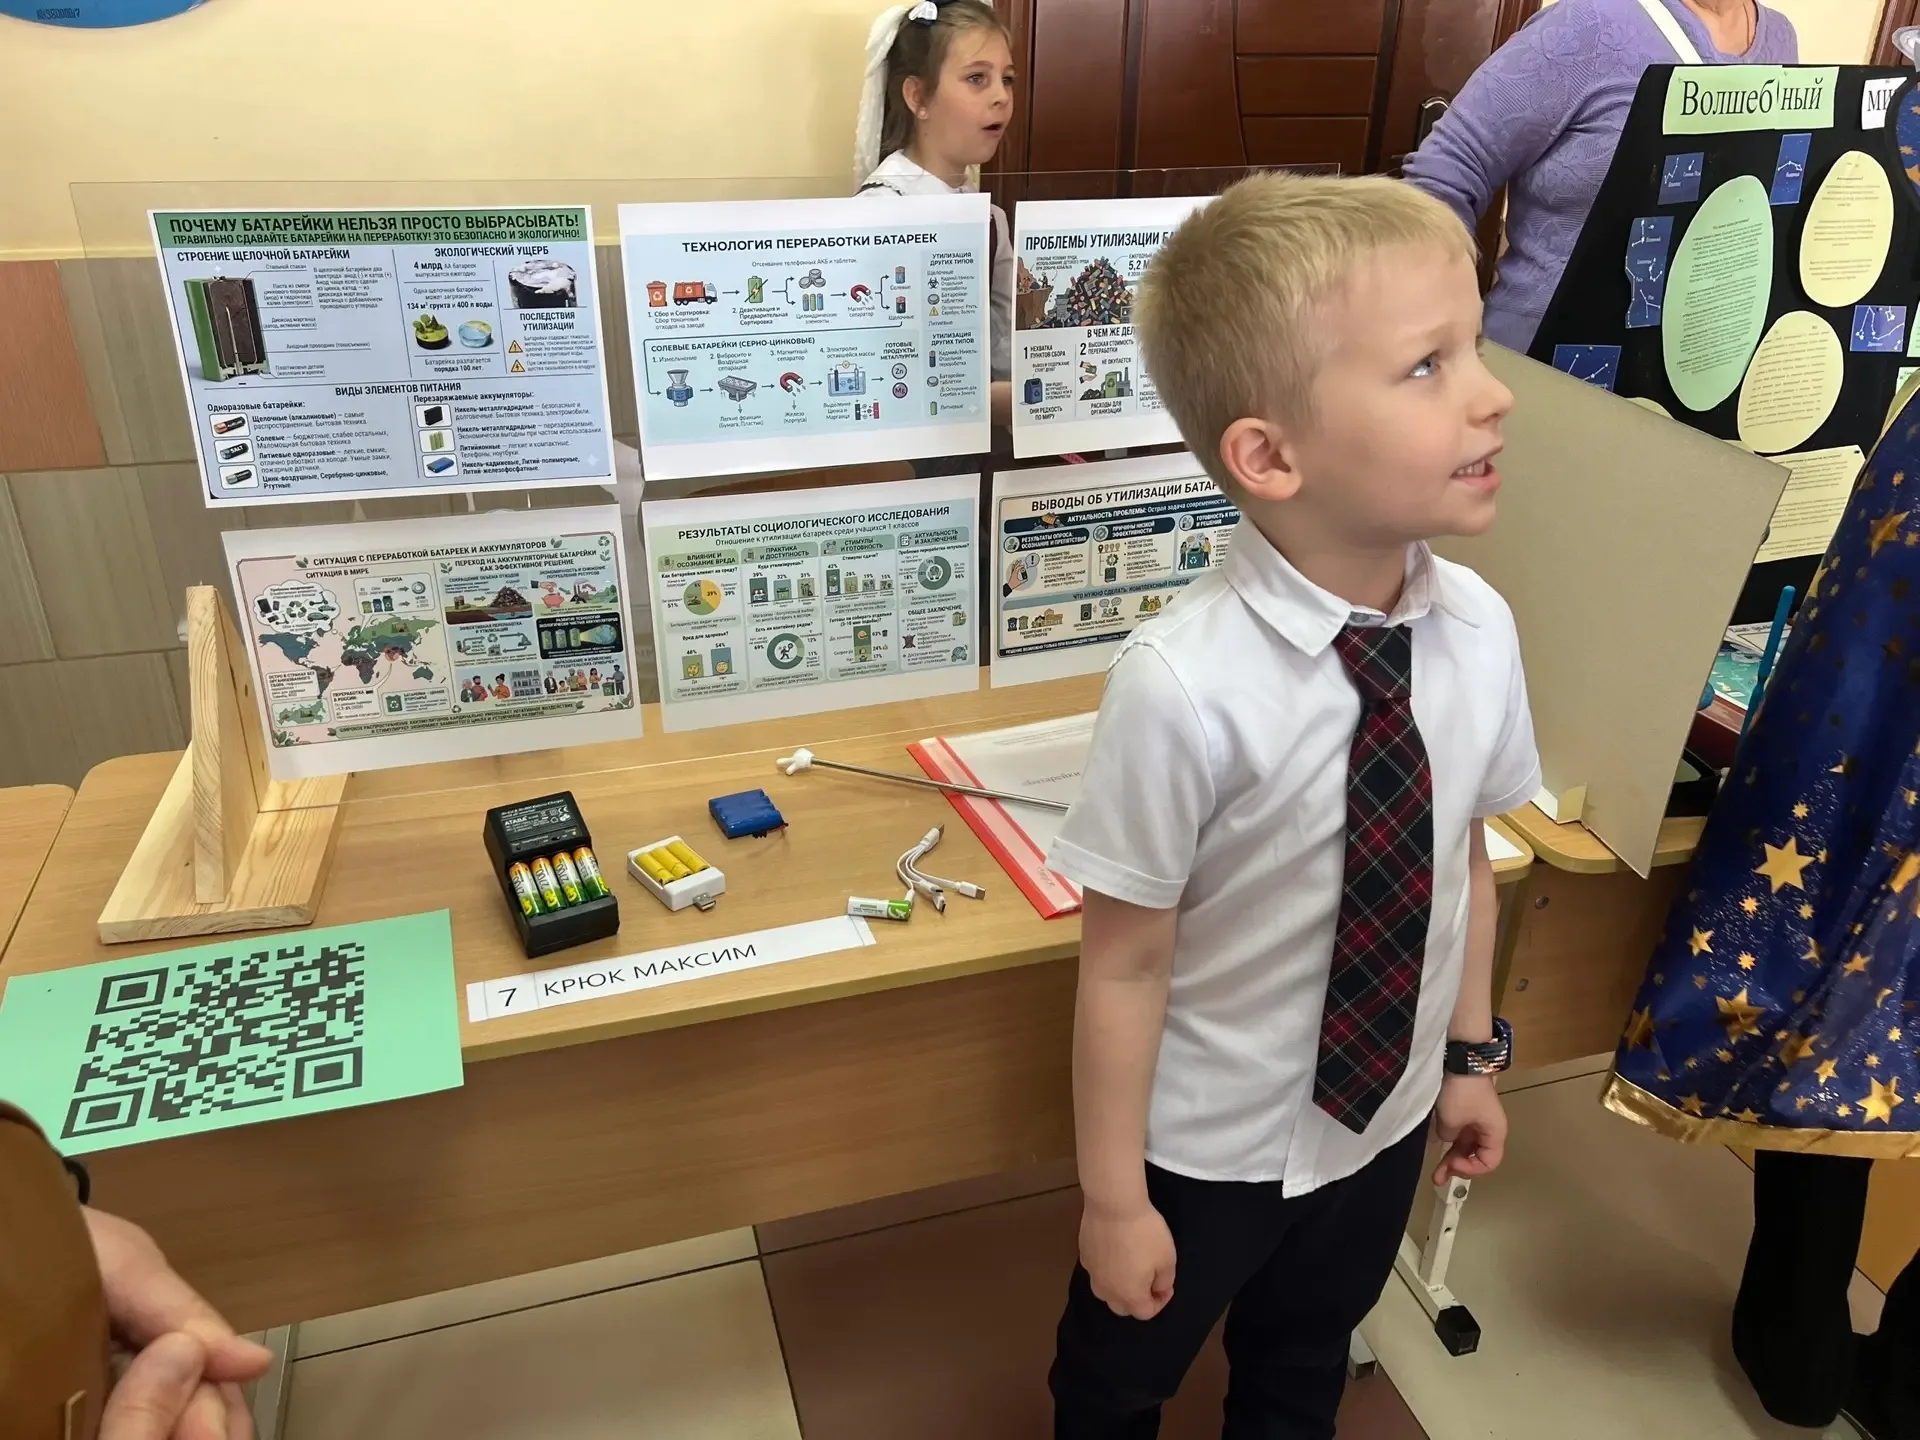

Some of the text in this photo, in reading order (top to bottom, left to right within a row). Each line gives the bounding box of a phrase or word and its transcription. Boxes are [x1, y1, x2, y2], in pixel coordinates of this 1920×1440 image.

[170, 214, 579, 233] ПОЧЕМУ БАТАРЕЙКИ НЕЛЬЗЯ ПРОСТО ВЫБРАСЫВАТЬ!
[173, 229, 580, 245] ПРАВИЛЬНО СДАВАЙТЕ БАТАРЕЙКИ НА ПЕРЕРАБОТКУ! ЭТО БЕЗОПАСНО И ЭКОЛОГИЧНО!
[682, 233, 938, 252] ТЕХНОЛОГИЯ ПЕРЕРАБОТКИ БАТАРЕЕК
[1026, 232, 1159, 250] ПРОБЛЕМЫ УТИЛИЗАЦИИ
[177, 249, 350, 263] СТРОЕНИЕ ЩЕЛОЧНОЙ БАТАРЕЙКИ
[434, 245, 549, 257] ЭКОЛОГИЧЕСКИЙ УЩЕРБ
[414, 262, 419, 270] 4
[421, 262, 443, 271] млрд
[1128, 260, 1141, 271] 5,2
[430, 302, 450, 310] грунта
[520, 311, 575, 321] ПОСЛЕДСТВИЯ
[523, 322, 574, 331] УТИЛИЗАЦИИ
[1087, 329, 1092, 338] В
[1093, 328, 1108, 337] ЧЕМ
[1110, 327, 1120, 336] ЖЕ
[651, 338, 815, 352] СОЛЕВЫЕ БАТАРЕЙКИ (СЕРНО-ЦИНКОВЫЕ)
[1080, 343, 1087, 355] 2
[1024, 347, 1028, 359] 1
[434, 365, 459, 373] порядка
[335, 382, 461, 396] ВИДЫ ЭЛЕМЕНТОВ ПИТАНИЯ
[413, 391, 535, 403] Перезаряжаемые аккумуляторы:
[207, 401, 305, 412] Одноразовые батарейки:
[252, 415, 287, 423] Щелочные
[289, 412, 337, 422] (алкалиновые)
[315, 419, 340, 427] Бытовая
[256, 434, 285, 442] Солевые
[259, 449, 336, 459] Литиевые одноразовые
[1031, 497, 1084, 511] ВЫВОДЫ
[1087, 494, 1103, 505] ОБ
[1106, 485, 1182, 503] УТИЛИЗАЦИИ
[1067, 512, 1112, 522] АКТУАЛЬНОСТЬ
[1113, 507, 1147, 517] ПРОБЛЕМЫ:
[678, 507, 950, 539] РЕЗУЛЬТАТЫ СОЦИОЛОГИЧЕСКОГО ИССЛЕДОВАНИЯ
[716, 538, 755, 546] Отношение
[762, 533, 801, 543] утилизации
[834, 527, 854, 536] среди
[855, 524, 887, 534] учащихся
[915, 529, 958, 538] АКТУАЛЬНОСТЬ
[919, 535, 957, 544] ЗАКЛЮЧЕНИЕ
[766, 545, 797, 553] ПРАКТИКА
[846, 543, 883, 551] ГОТОВНОСТЬ
[313, 557, 358, 566] СИТУАЦИЯ
[366, 549, 429, 562] ПЕРЕРАБОТКОЙ
[430, 547, 470, 557] БАТАРЕЕК
[479, 541, 547, 553] АККУМУЛЯТОРОВ
[455, 559, 485, 567] ПЕРЕХОД
[498, 552, 558, 562] АККУМУЛЯТОРНЫЕ
[560, 550, 597, 558] БАТАРЕЙКИ
[765, 550, 809, 560] ДОСТУПНОСТЬ
[495, 561, 542, 570] ЭФФЕКТИВНОЕ
[677, 559, 714, 568] ОСОЗНАНИЕ
[305, 570, 342, 579] СИТУАЦИЯ
[498, 944, 757, 1007] 7 КРЮК МАКСИМ
